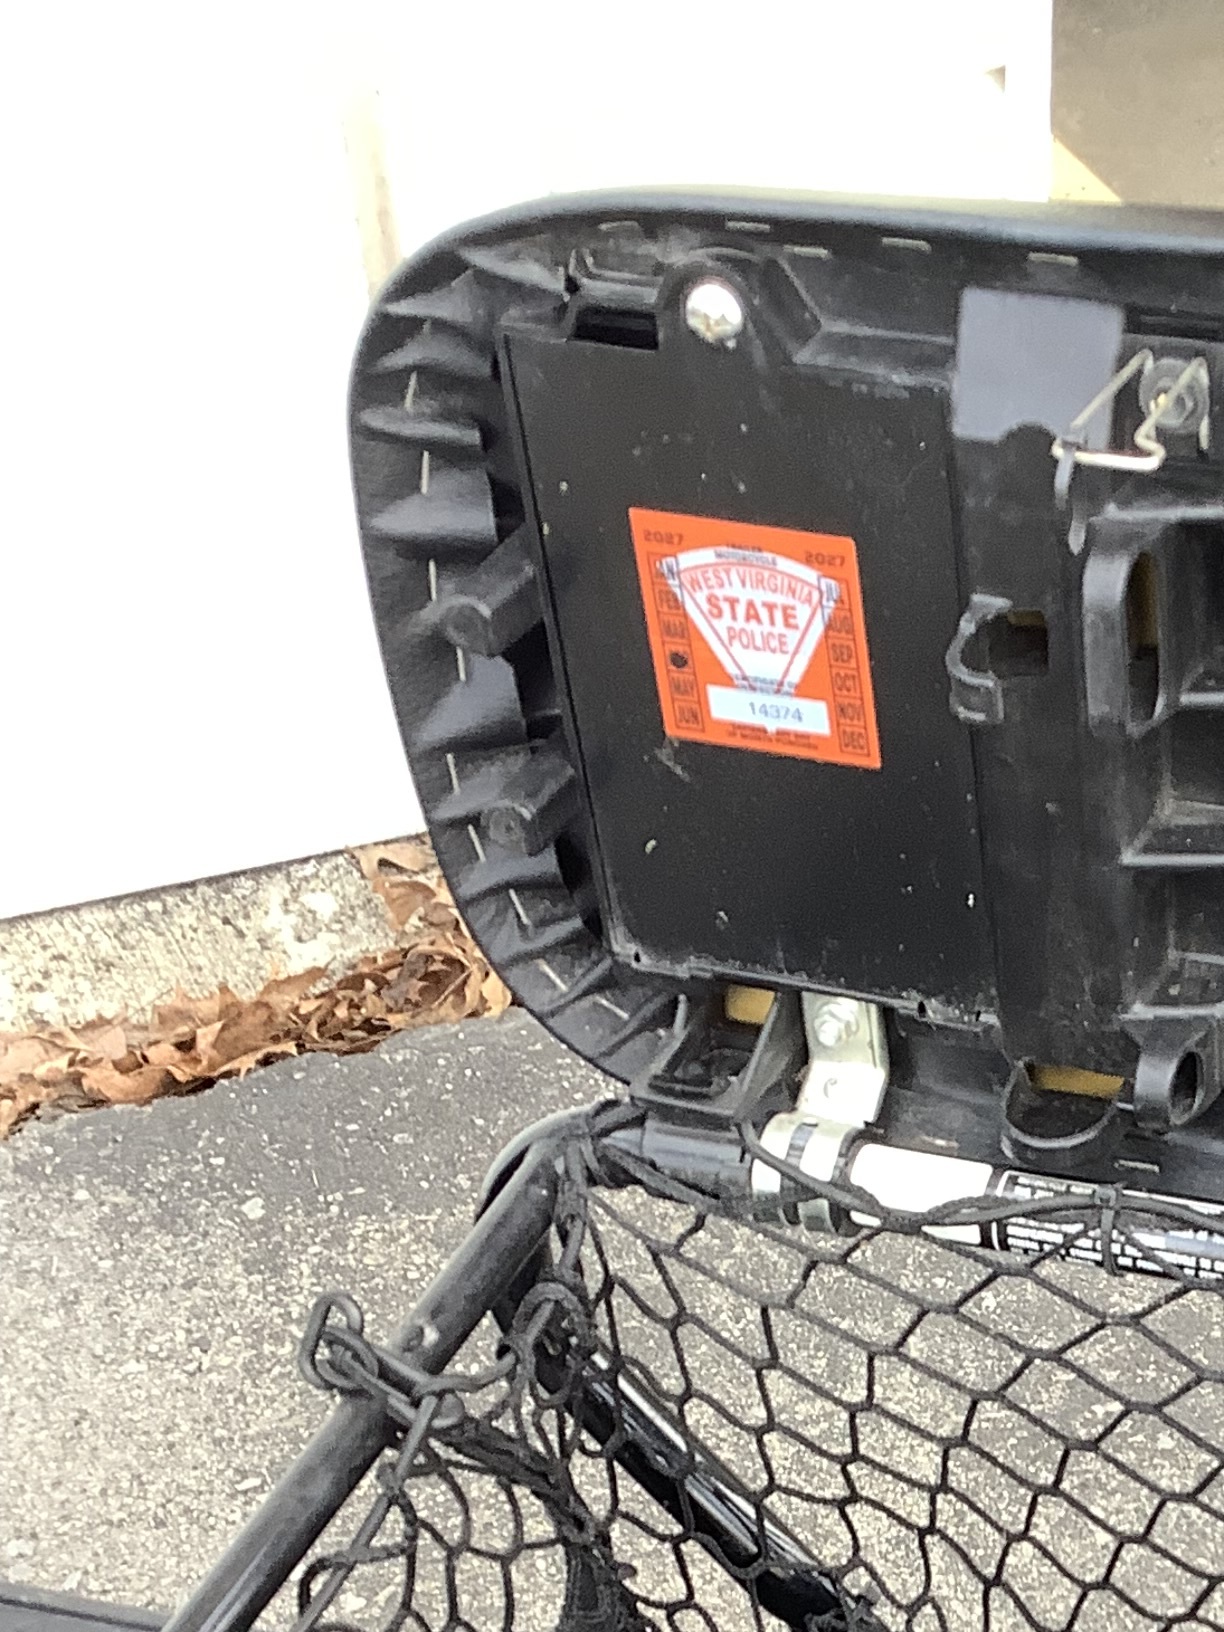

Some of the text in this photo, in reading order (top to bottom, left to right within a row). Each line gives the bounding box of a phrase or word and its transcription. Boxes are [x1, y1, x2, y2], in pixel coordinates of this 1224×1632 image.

[687, 568, 814, 606] WEST VIRGINIA
[706, 595, 800, 631] STATE
[726, 625, 790, 656] POLICE
[671, 676, 695, 698] MAY
[834, 670, 858, 693] OCT
[677, 704, 700, 726] JUN
[838, 702, 864, 723] NOV
[842, 728, 866, 751] DEC
